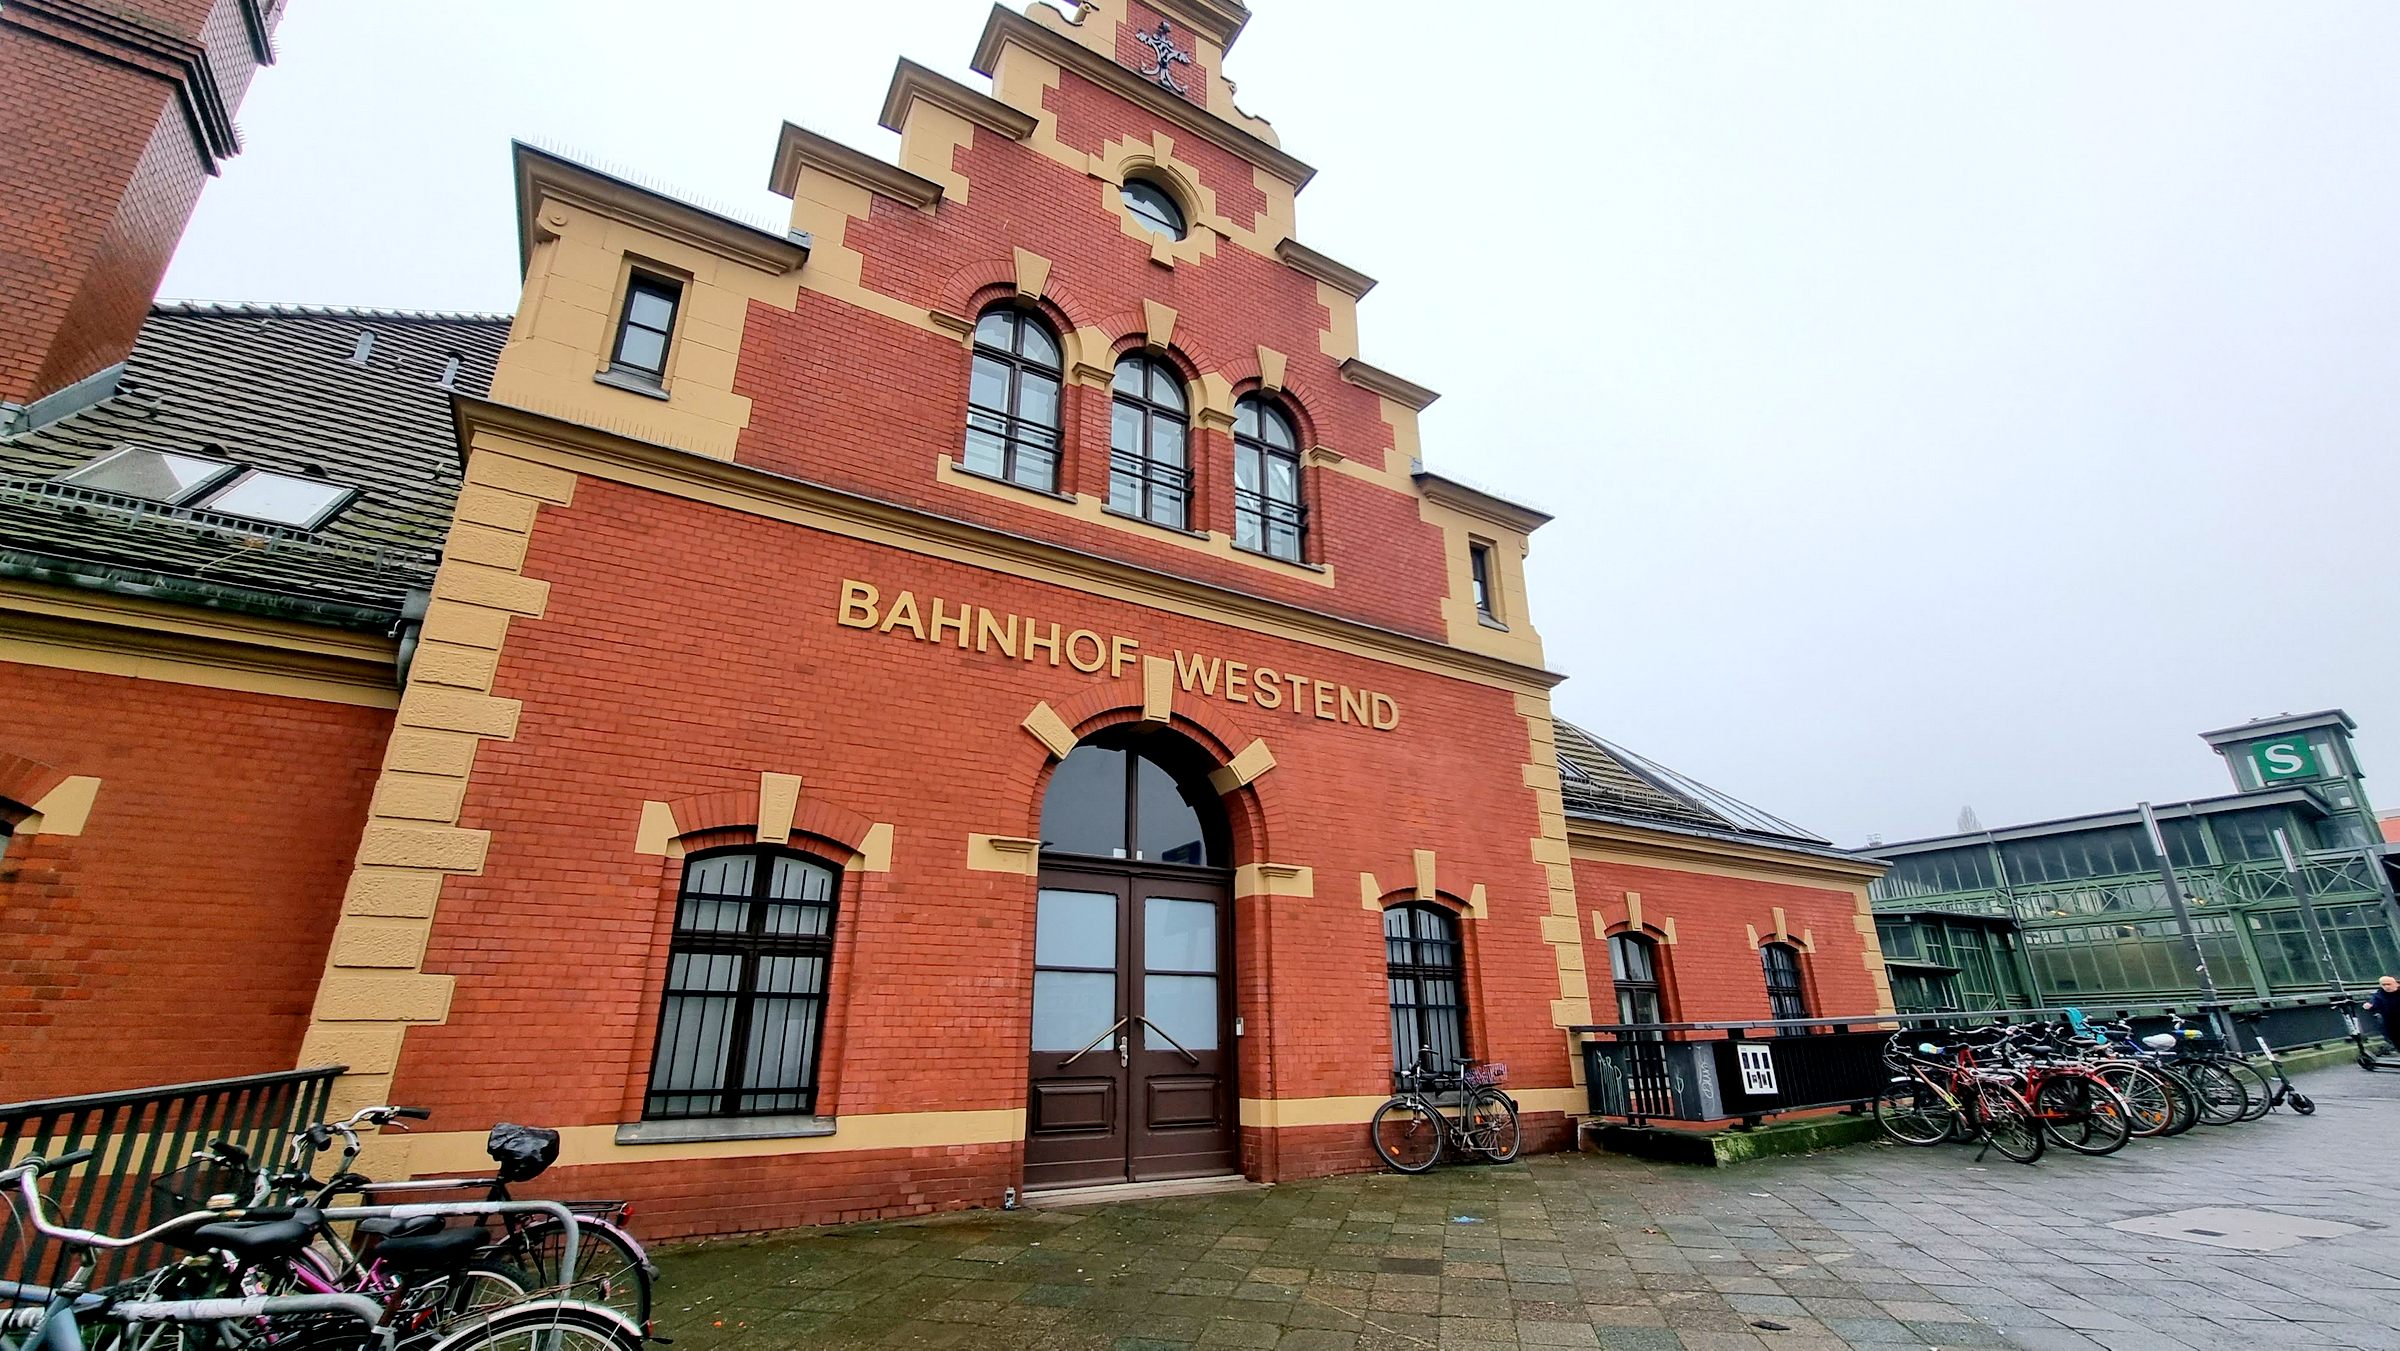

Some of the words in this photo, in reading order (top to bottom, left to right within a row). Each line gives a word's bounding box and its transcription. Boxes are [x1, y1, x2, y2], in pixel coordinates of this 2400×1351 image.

[838, 578, 1139, 678] BAHNHOF
[1173, 649, 1400, 731] WESTEND
[2265, 744, 2303, 774] S
